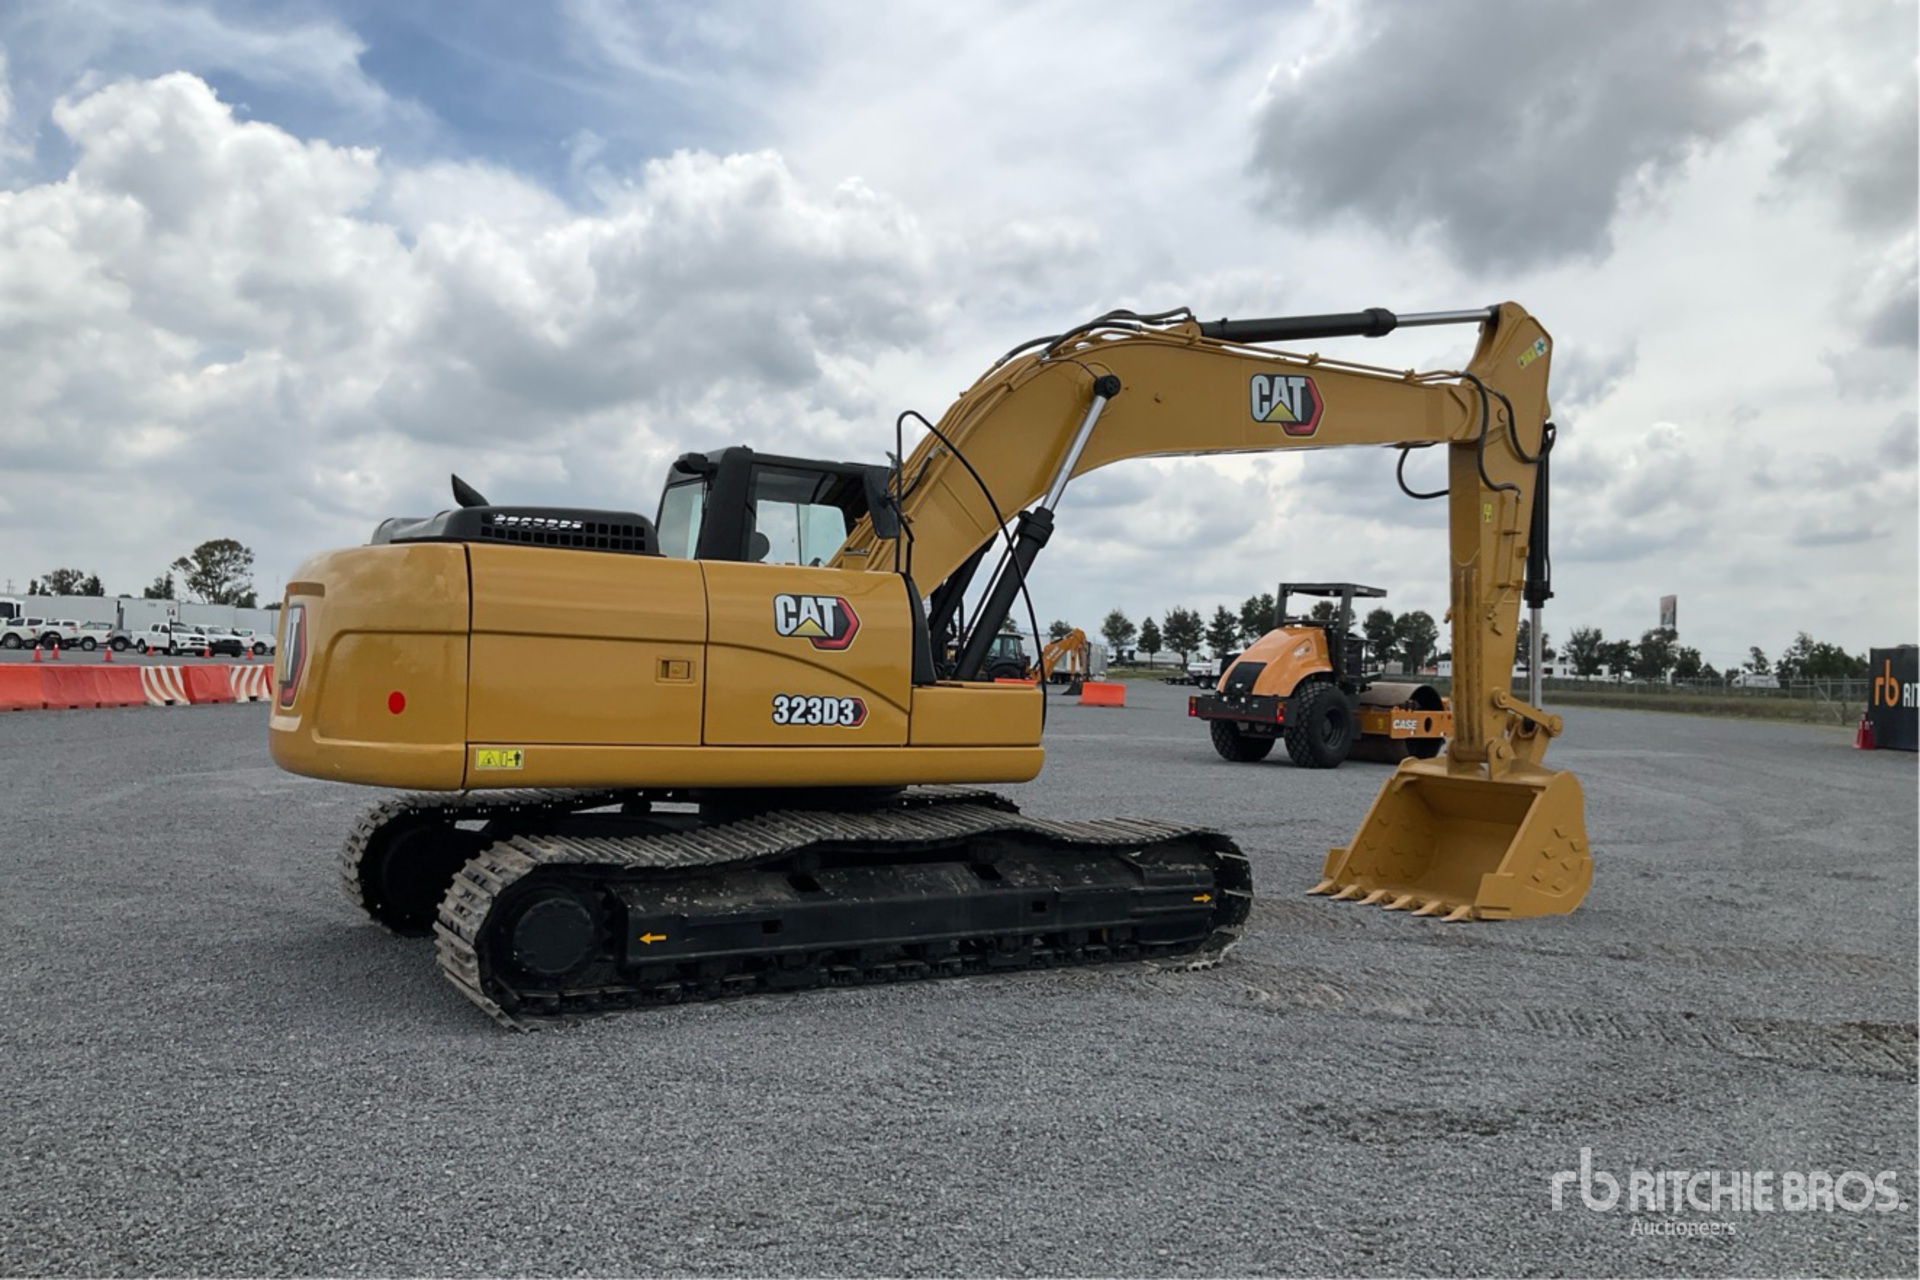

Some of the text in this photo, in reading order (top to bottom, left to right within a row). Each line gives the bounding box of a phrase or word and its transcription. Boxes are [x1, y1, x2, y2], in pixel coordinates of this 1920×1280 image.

[1251, 374, 1306, 422] CAT
[774, 594, 837, 637] CAT
[1874, 659, 1899, 707] rb
[773, 695, 854, 726] 323D3
[1393, 719, 1417, 730] CASE
